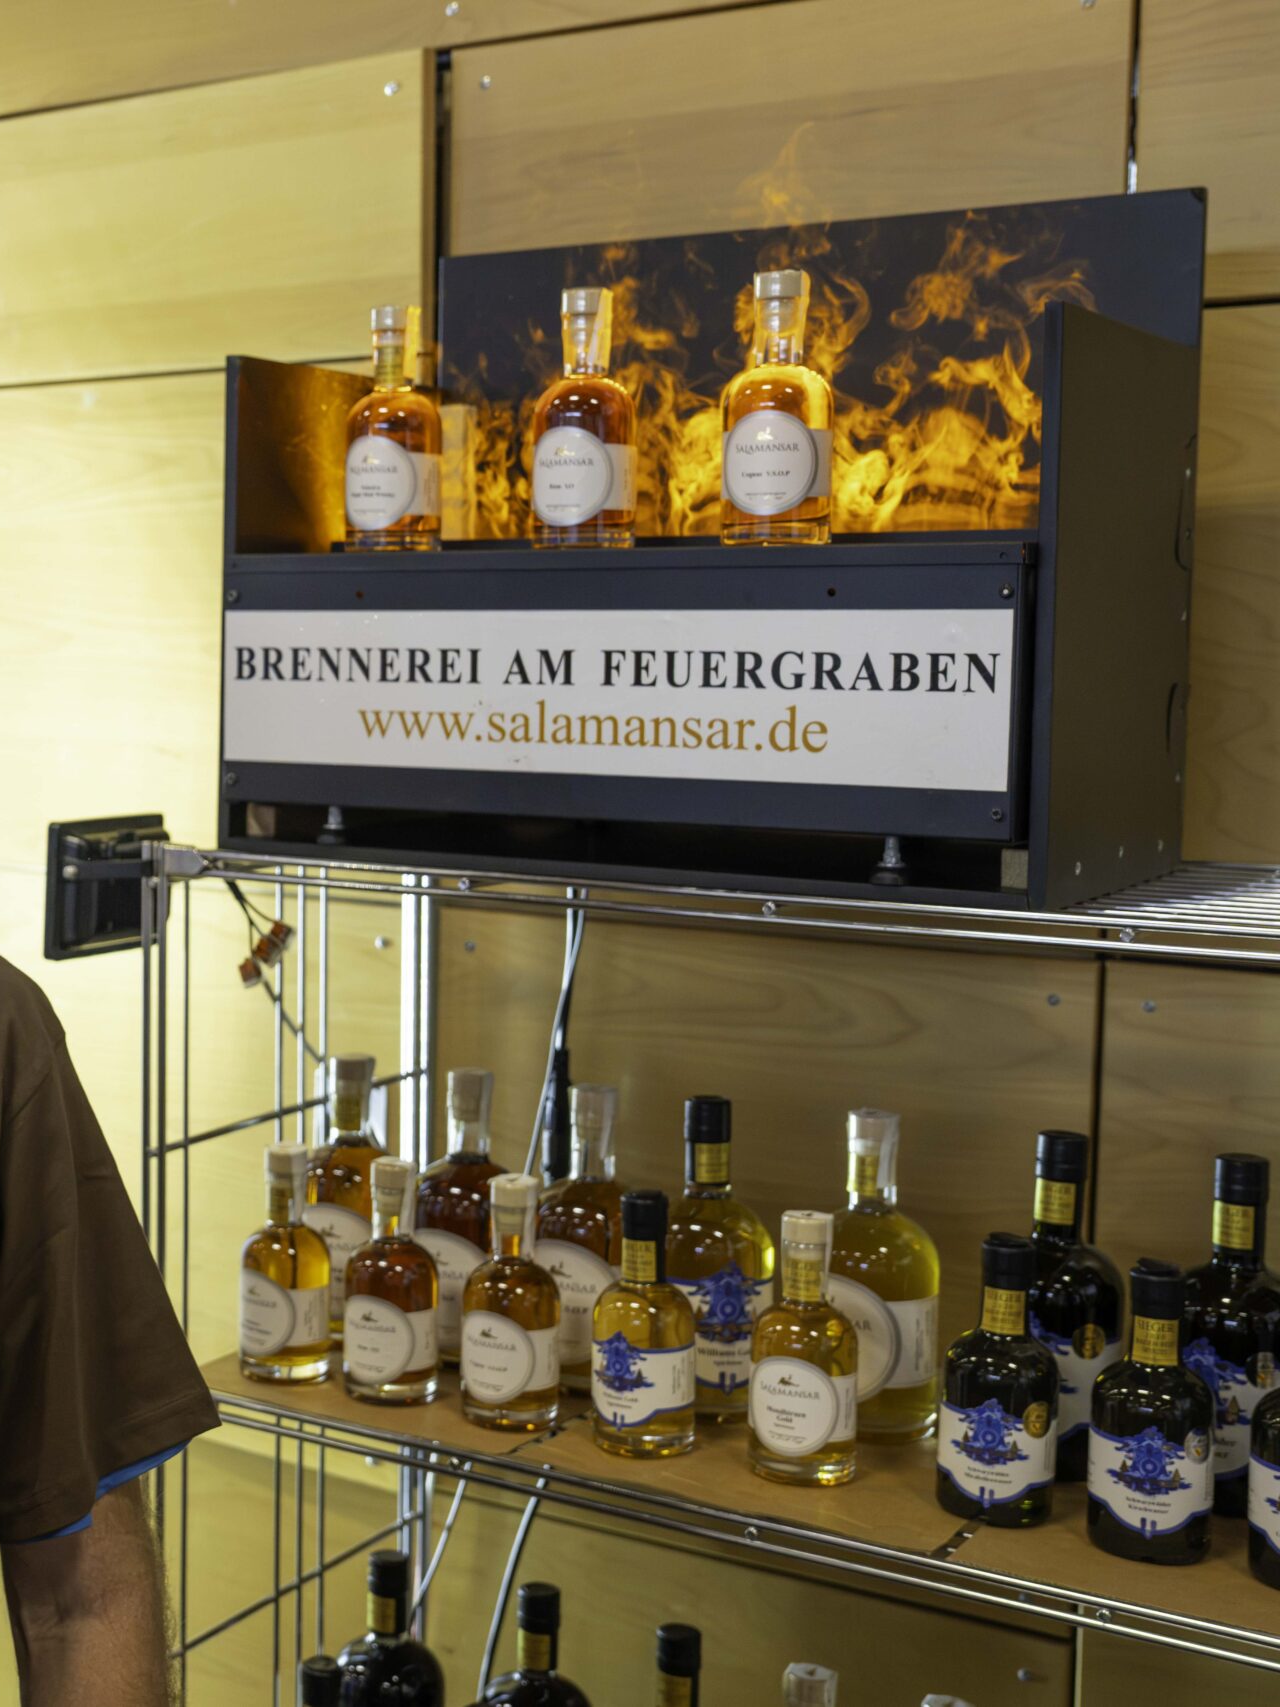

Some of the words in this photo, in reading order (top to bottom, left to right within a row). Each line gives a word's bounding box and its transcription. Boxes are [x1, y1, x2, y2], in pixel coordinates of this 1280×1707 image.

[235, 646, 482, 685] BRENNEREI
[502, 649, 576, 686] AM
[601, 649, 1001, 694] FEUERGRABEN
[358, 698, 829, 754] www.salamansar.de
